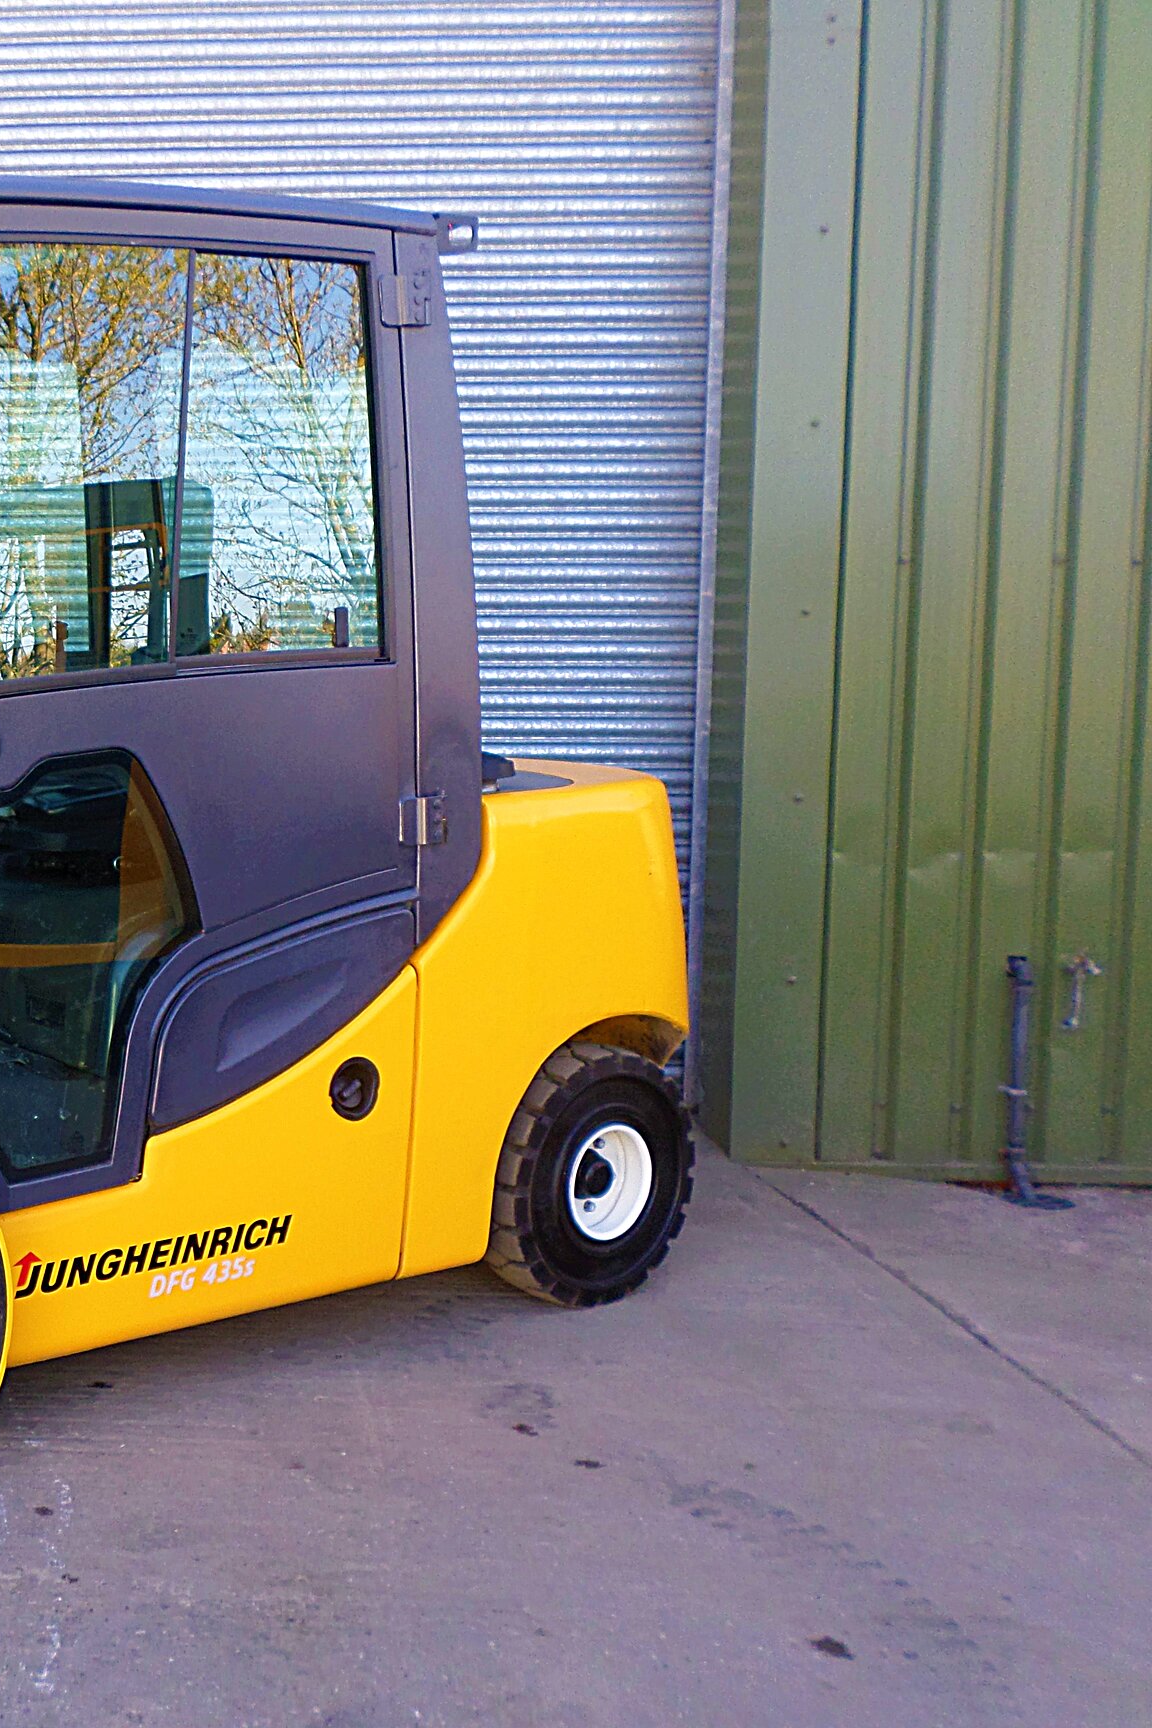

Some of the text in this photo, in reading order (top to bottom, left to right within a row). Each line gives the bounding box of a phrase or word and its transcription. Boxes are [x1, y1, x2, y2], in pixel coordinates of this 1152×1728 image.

[14, 1214, 292, 1300] JUNGHEINRICH
[148, 1255, 256, 1299] DFG 435s
